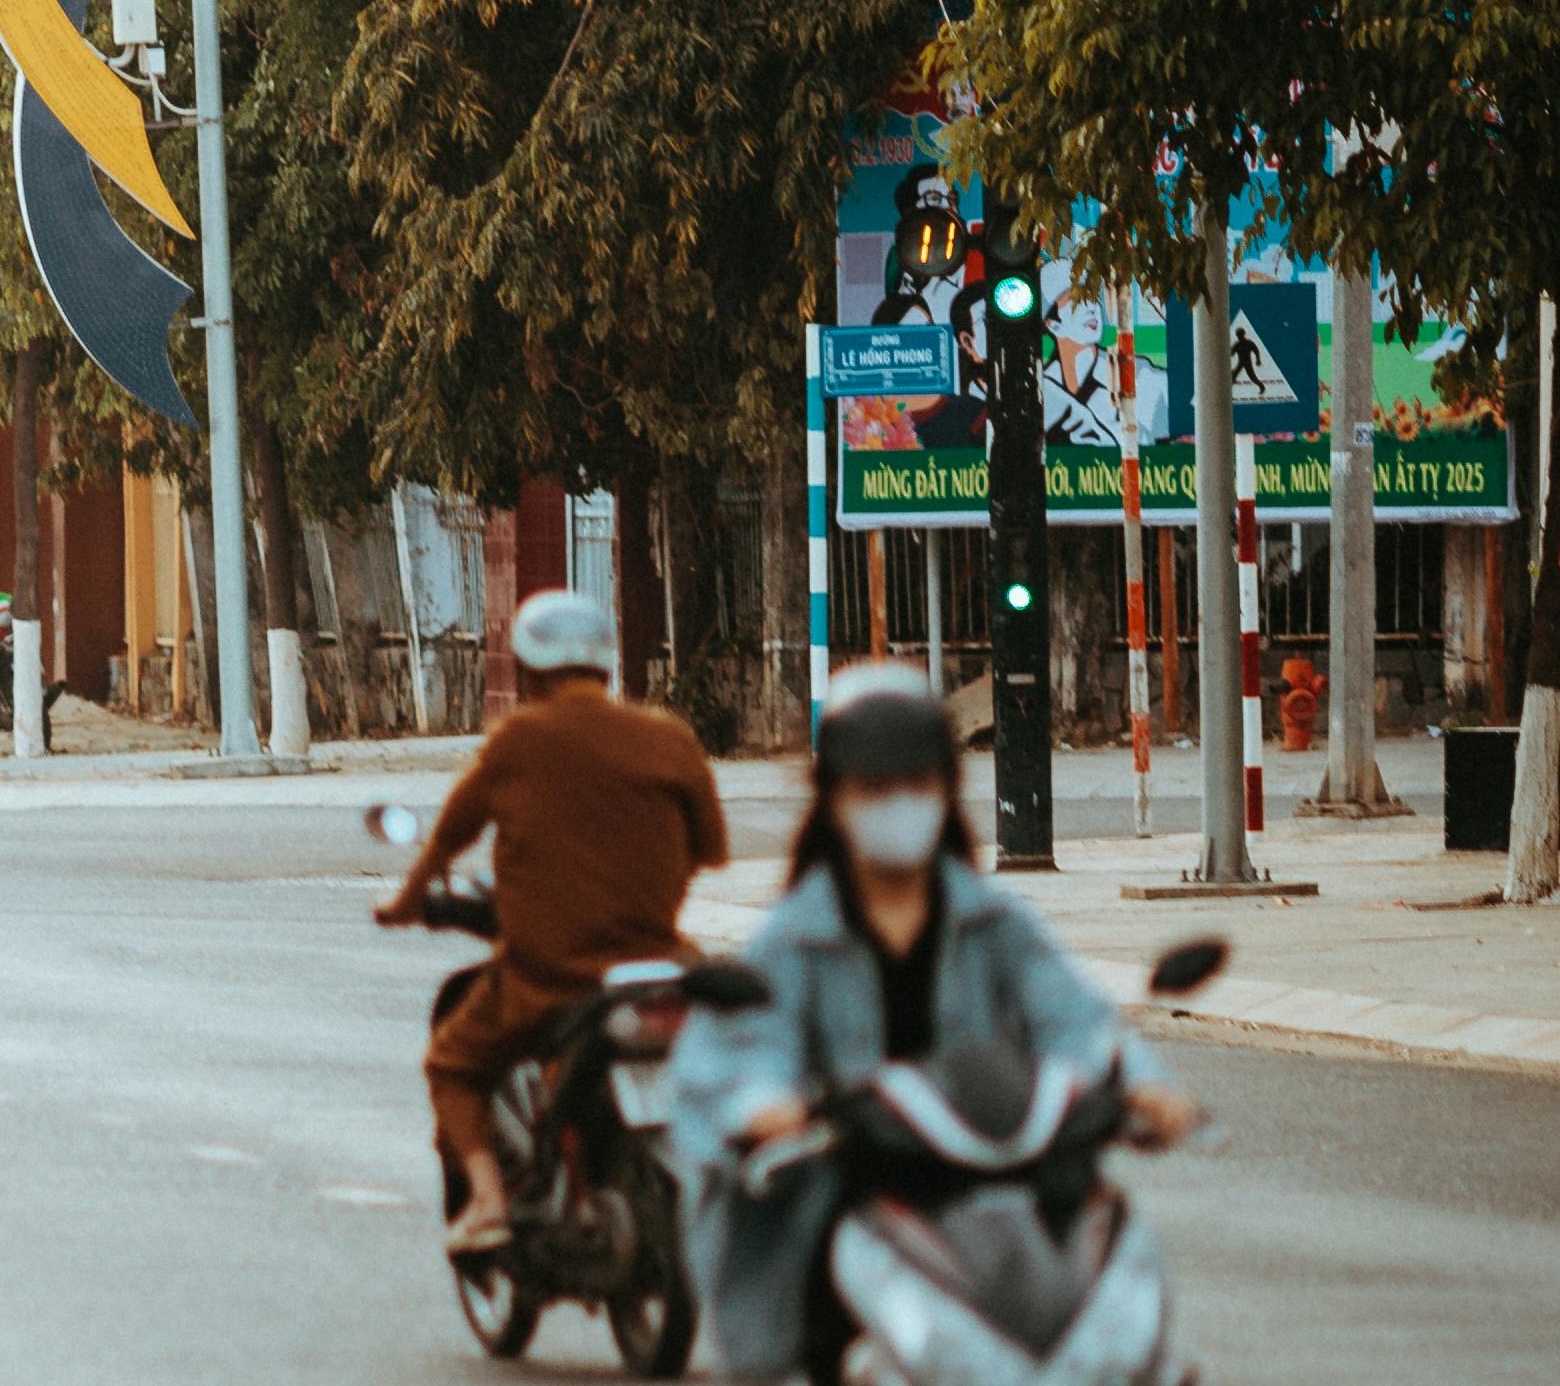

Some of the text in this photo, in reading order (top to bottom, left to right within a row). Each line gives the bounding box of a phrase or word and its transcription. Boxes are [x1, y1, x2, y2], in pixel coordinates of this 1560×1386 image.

[921, 222, 956, 264] 11
[841, 346, 933, 367] LÊ HỒNG PHONG
[862, 461, 911, 499] MỪNG
[915, 455, 948, 499] ĐẤT
[952, 459, 989, 498] NƯỚ
[1255, 463, 1286, 498] INH,
[1291, 454, 1331, 493] MỪN
[1395, 455, 1416, 493] ẤT
[1419, 462, 1439, 501] TỴ
[1446, 462, 1485, 494] 2025
